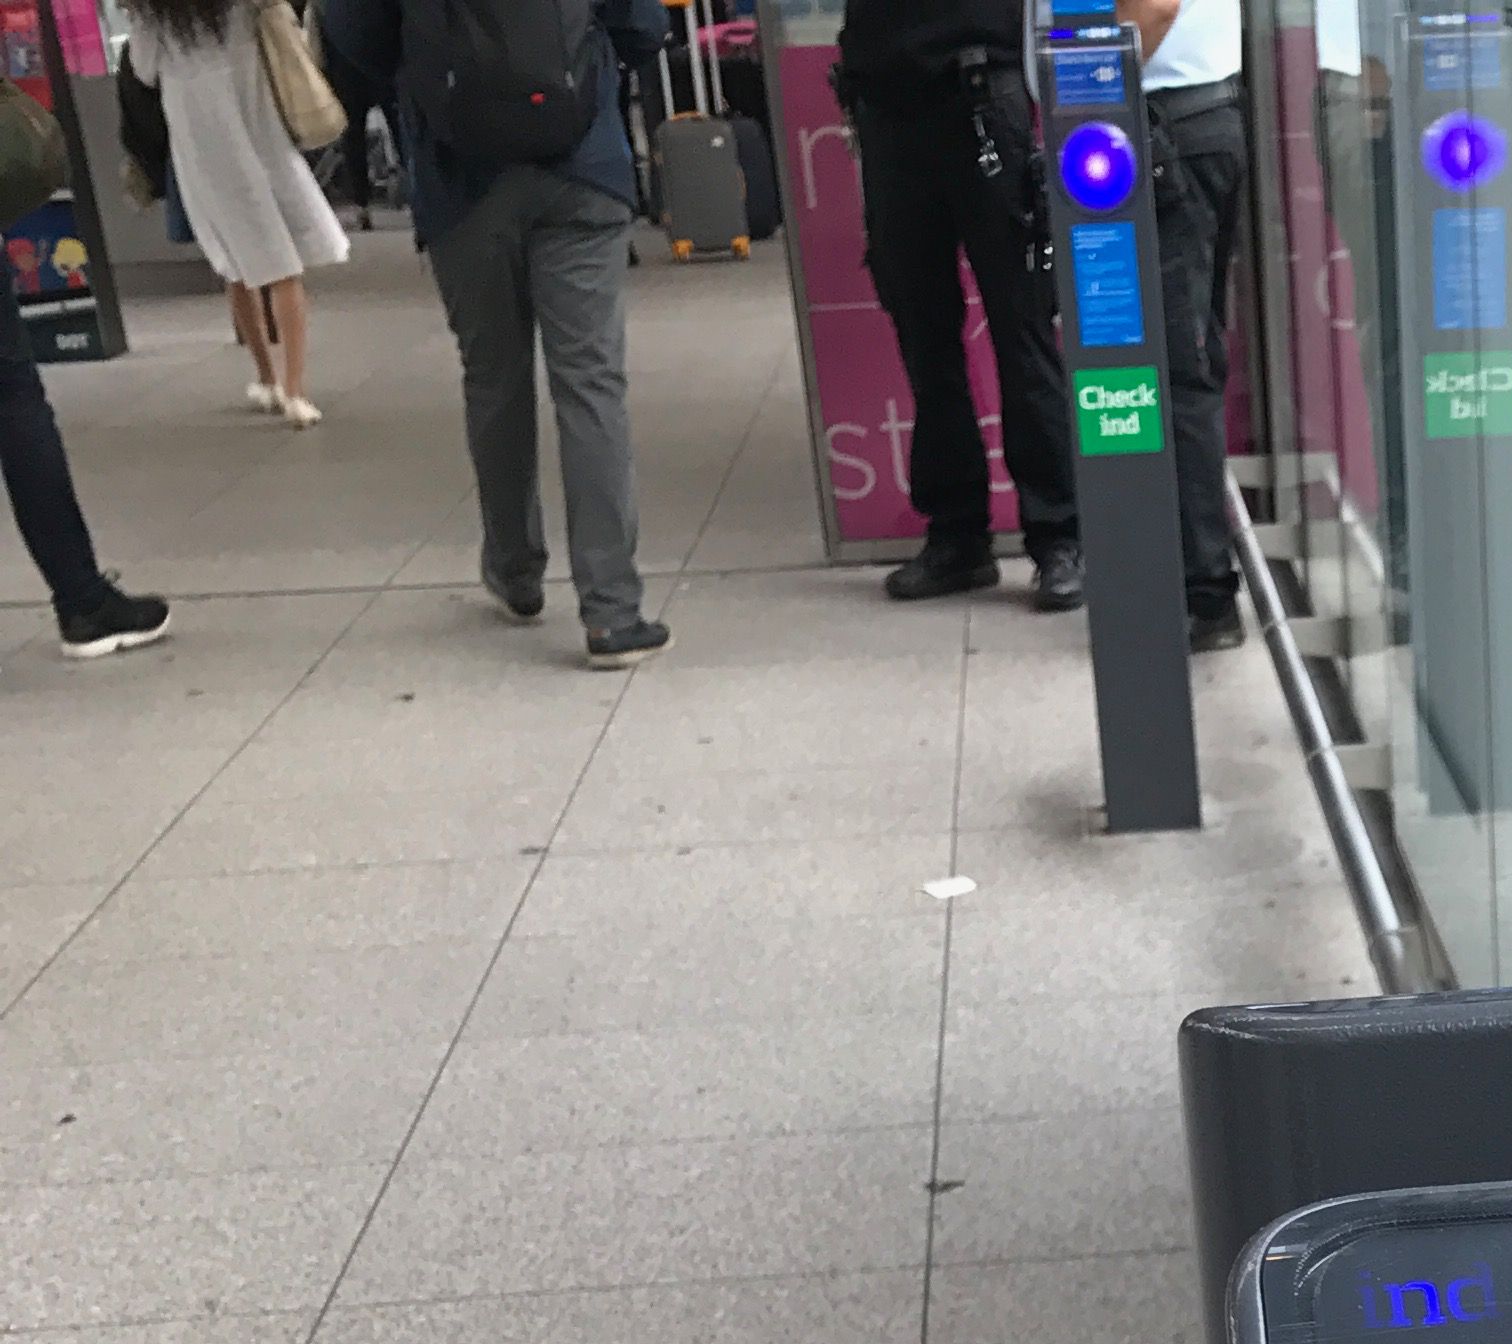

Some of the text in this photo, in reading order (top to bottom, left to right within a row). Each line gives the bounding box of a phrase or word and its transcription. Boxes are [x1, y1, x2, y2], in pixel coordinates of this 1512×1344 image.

[1078, 382, 1158, 410] Check
[1099, 411, 1141, 436] ind
[1356, 1260, 1503, 1329] ind
